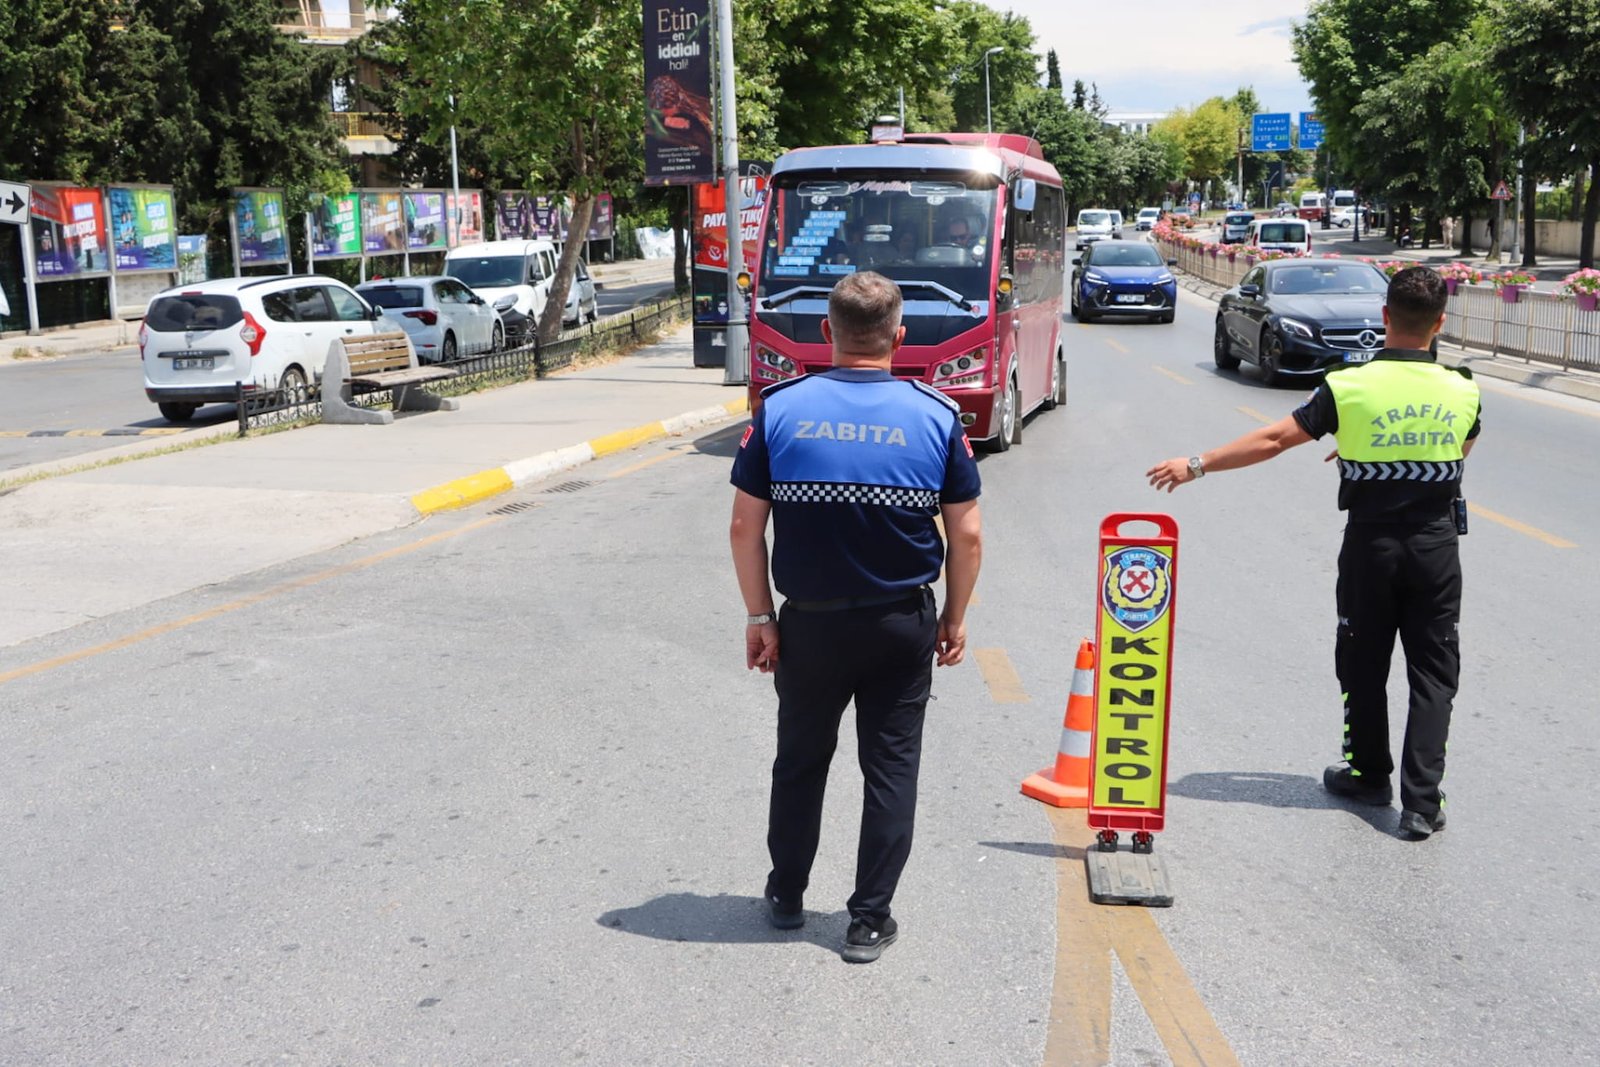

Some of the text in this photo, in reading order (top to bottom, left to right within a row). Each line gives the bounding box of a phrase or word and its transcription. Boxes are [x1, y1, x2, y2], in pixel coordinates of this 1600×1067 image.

[657, 7, 698, 33] Etin
[672, 32, 685, 41] en
[658, 41, 700, 59] iddialı
[1371, 403, 1457, 430] TRAFİK
[794, 420, 907, 445] ZABITA
[1370, 431, 1456, 447] ZABITA
[1104, 636, 1160, 806] KONTROL
